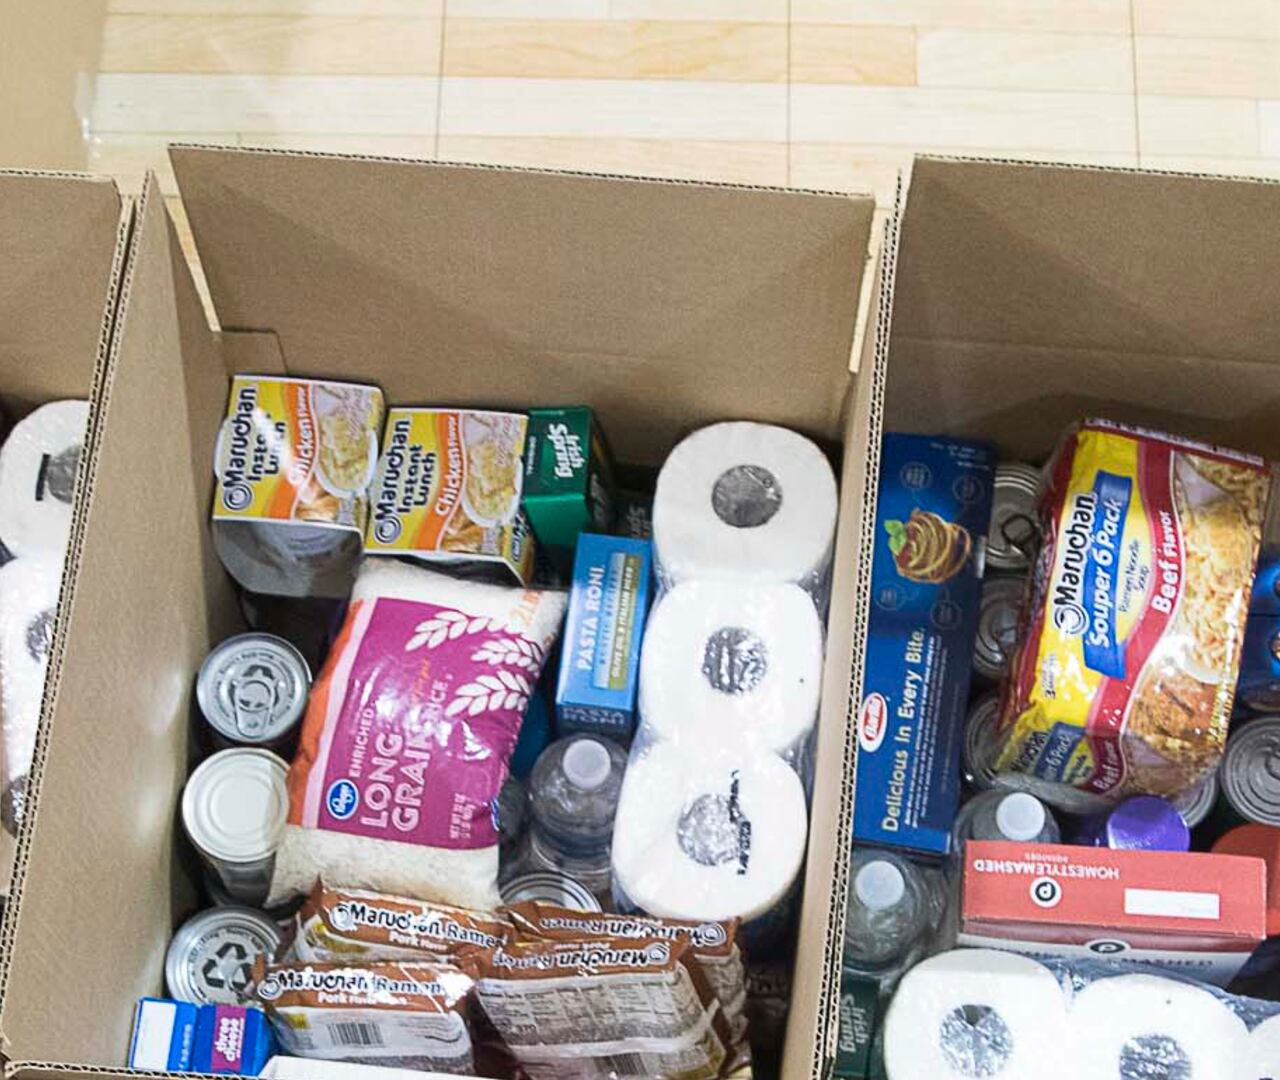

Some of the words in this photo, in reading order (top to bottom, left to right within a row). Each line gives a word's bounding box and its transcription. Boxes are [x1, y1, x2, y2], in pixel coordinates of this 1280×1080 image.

[223, 387, 257, 487] Maruchan
[548, 423, 573, 479] Spring
[568, 424, 587, 469] Irish
[375, 419, 410, 520] Maruchan
[397, 444, 422, 513] Instant
[413, 452, 437, 506] Lunch
[436, 442, 463, 516] Chicken
[1097, 498, 1123, 547] Pack
[1159, 510, 1176, 559] Flavor
[1053, 494, 1094, 606] Maruchan
[1093, 547, 1109, 565] 6
[1086, 567, 1113, 648] Souper
[1152, 561, 1177, 616] Beef
[576, 619, 597, 671] PASTA
[906, 627, 926, 666] Bite.
[897, 668, 919, 720] Every
[349, 709, 373, 778] ENRICHED
[895, 724, 911, 752] In
[333, 783, 355, 814] Kroger
[361, 732, 404, 830] LONG
[883, 752, 908, 833] Delicious
[1093, 764, 1118, 792] Beef
[349, 904, 443, 940] Maruchan
[447, 923, 508, 950] Ramen
[278, 970, 375, 991] Maruchan
[377, 976, 441, 994] Ramen
[559, 947, 649, 968] Maruchan
[214, 1017, 228, 1055] three
[224, 1016, 236, 1062] cheese
[853, 1004, 870, 1044] Irish
